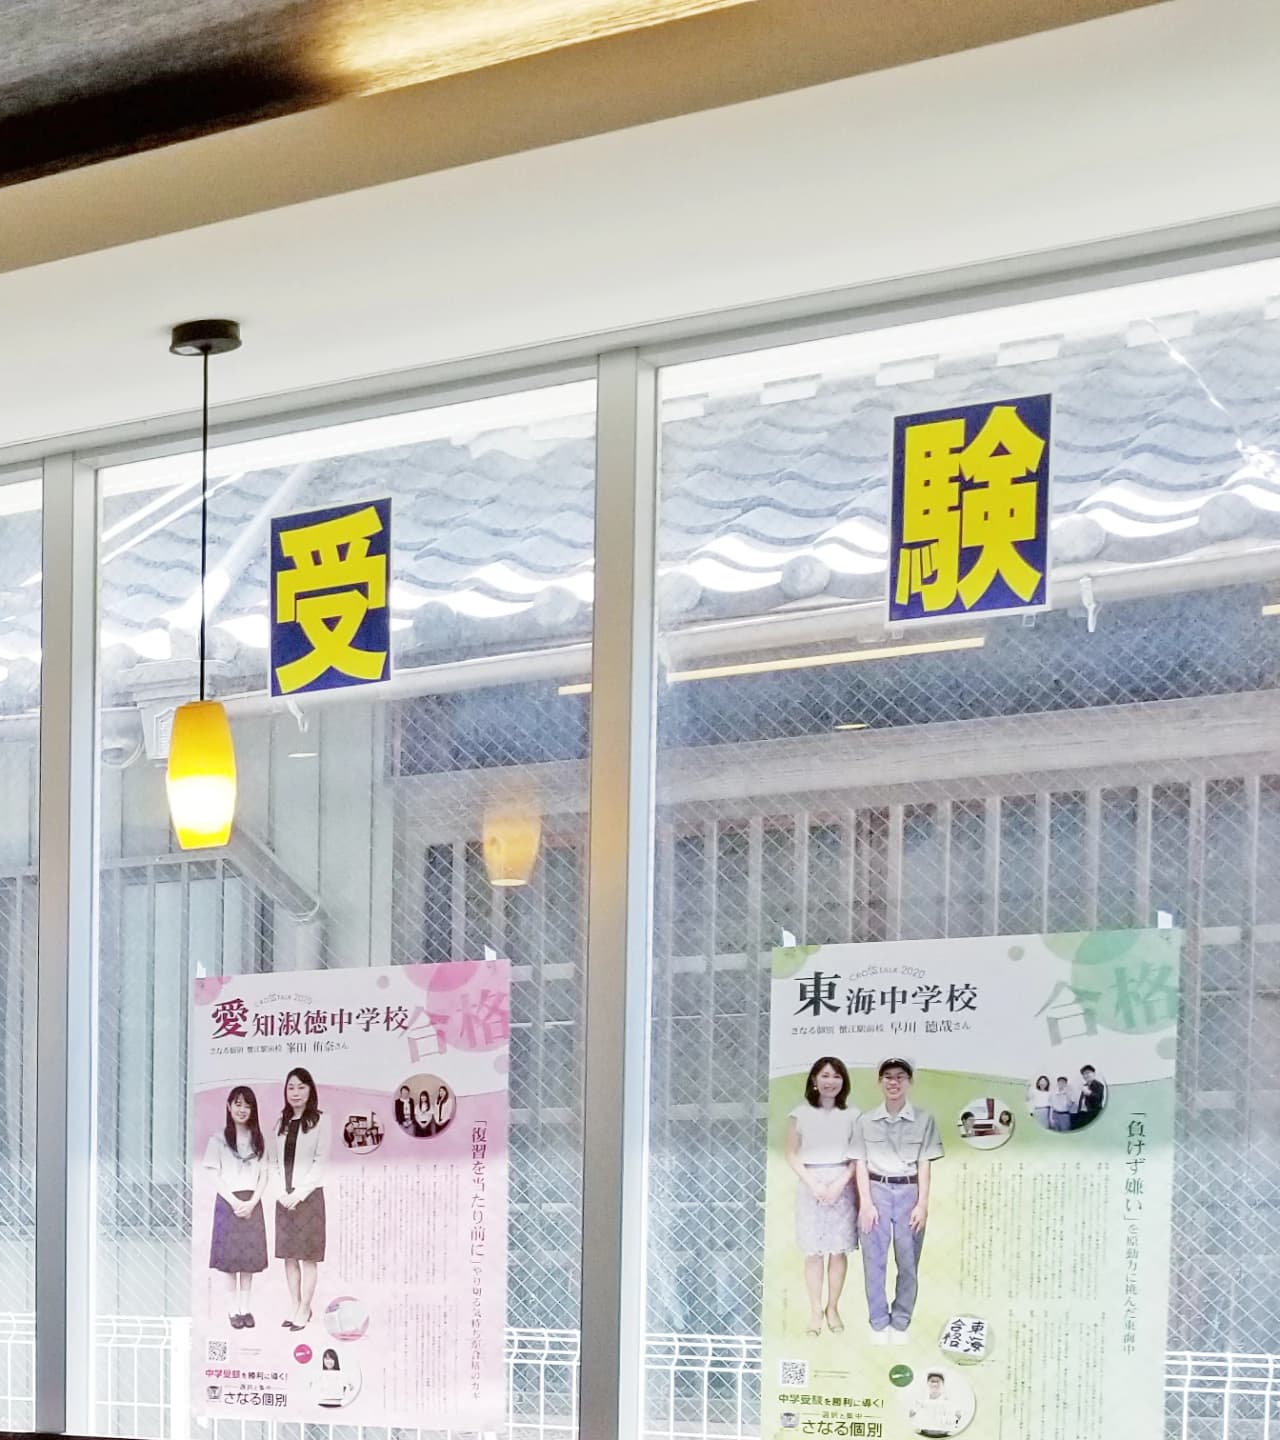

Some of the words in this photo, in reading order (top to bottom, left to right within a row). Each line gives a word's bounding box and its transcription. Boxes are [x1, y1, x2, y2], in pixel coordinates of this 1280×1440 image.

[275, 505, 387, 694] 受
[895, 406, 1045, 612] 験
[793, 971, 978, 1016] 東海中学校
[211, 998, 410, 1039] 愛知淑徳中学校
[399, 989, 509, 1063] 合格
[223, 1391, 288, 1408] さなる個別
[801, 1420, 883, 1438] さなる個別
